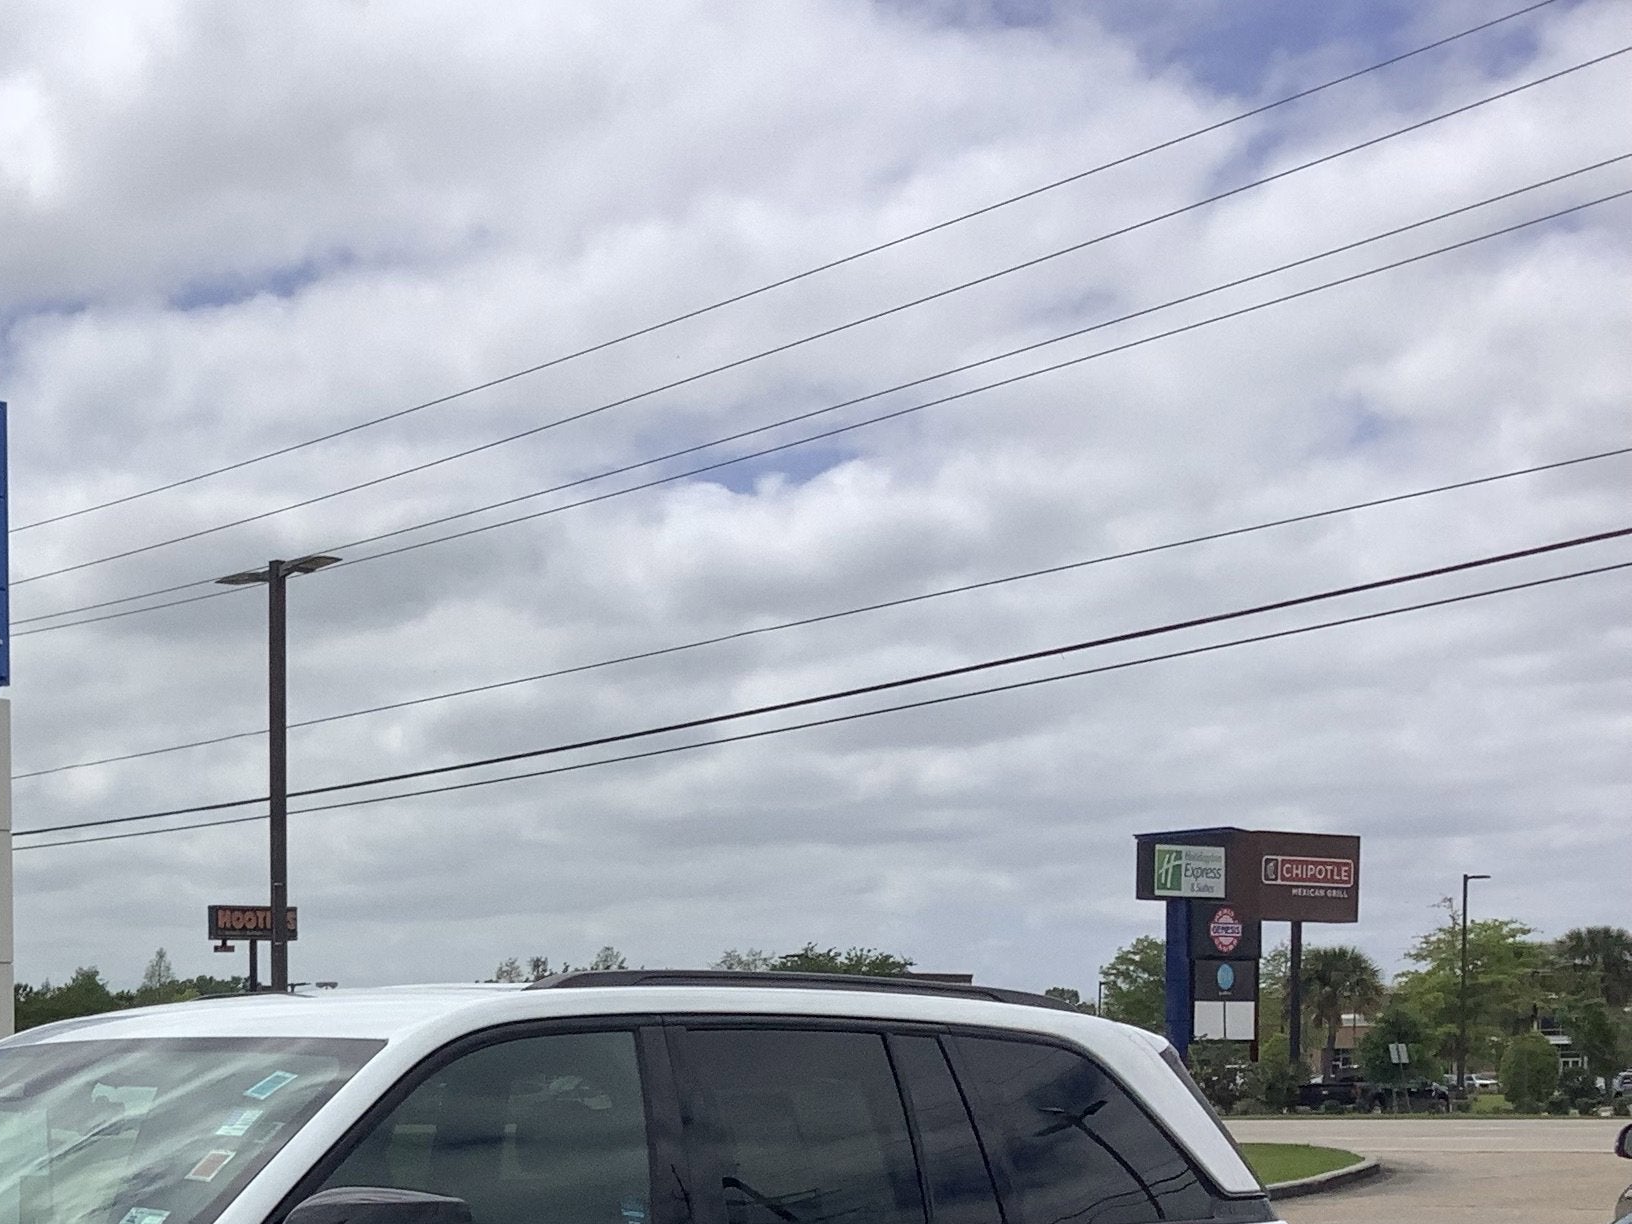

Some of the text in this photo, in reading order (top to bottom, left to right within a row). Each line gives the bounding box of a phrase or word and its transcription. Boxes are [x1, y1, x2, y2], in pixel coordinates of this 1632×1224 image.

[1184, 862, 1222, 881] Express
[1282, 863, 1349, 880] CHIPOTLE
[1291, 888, 1348, 898] MEXICAN GRILL
